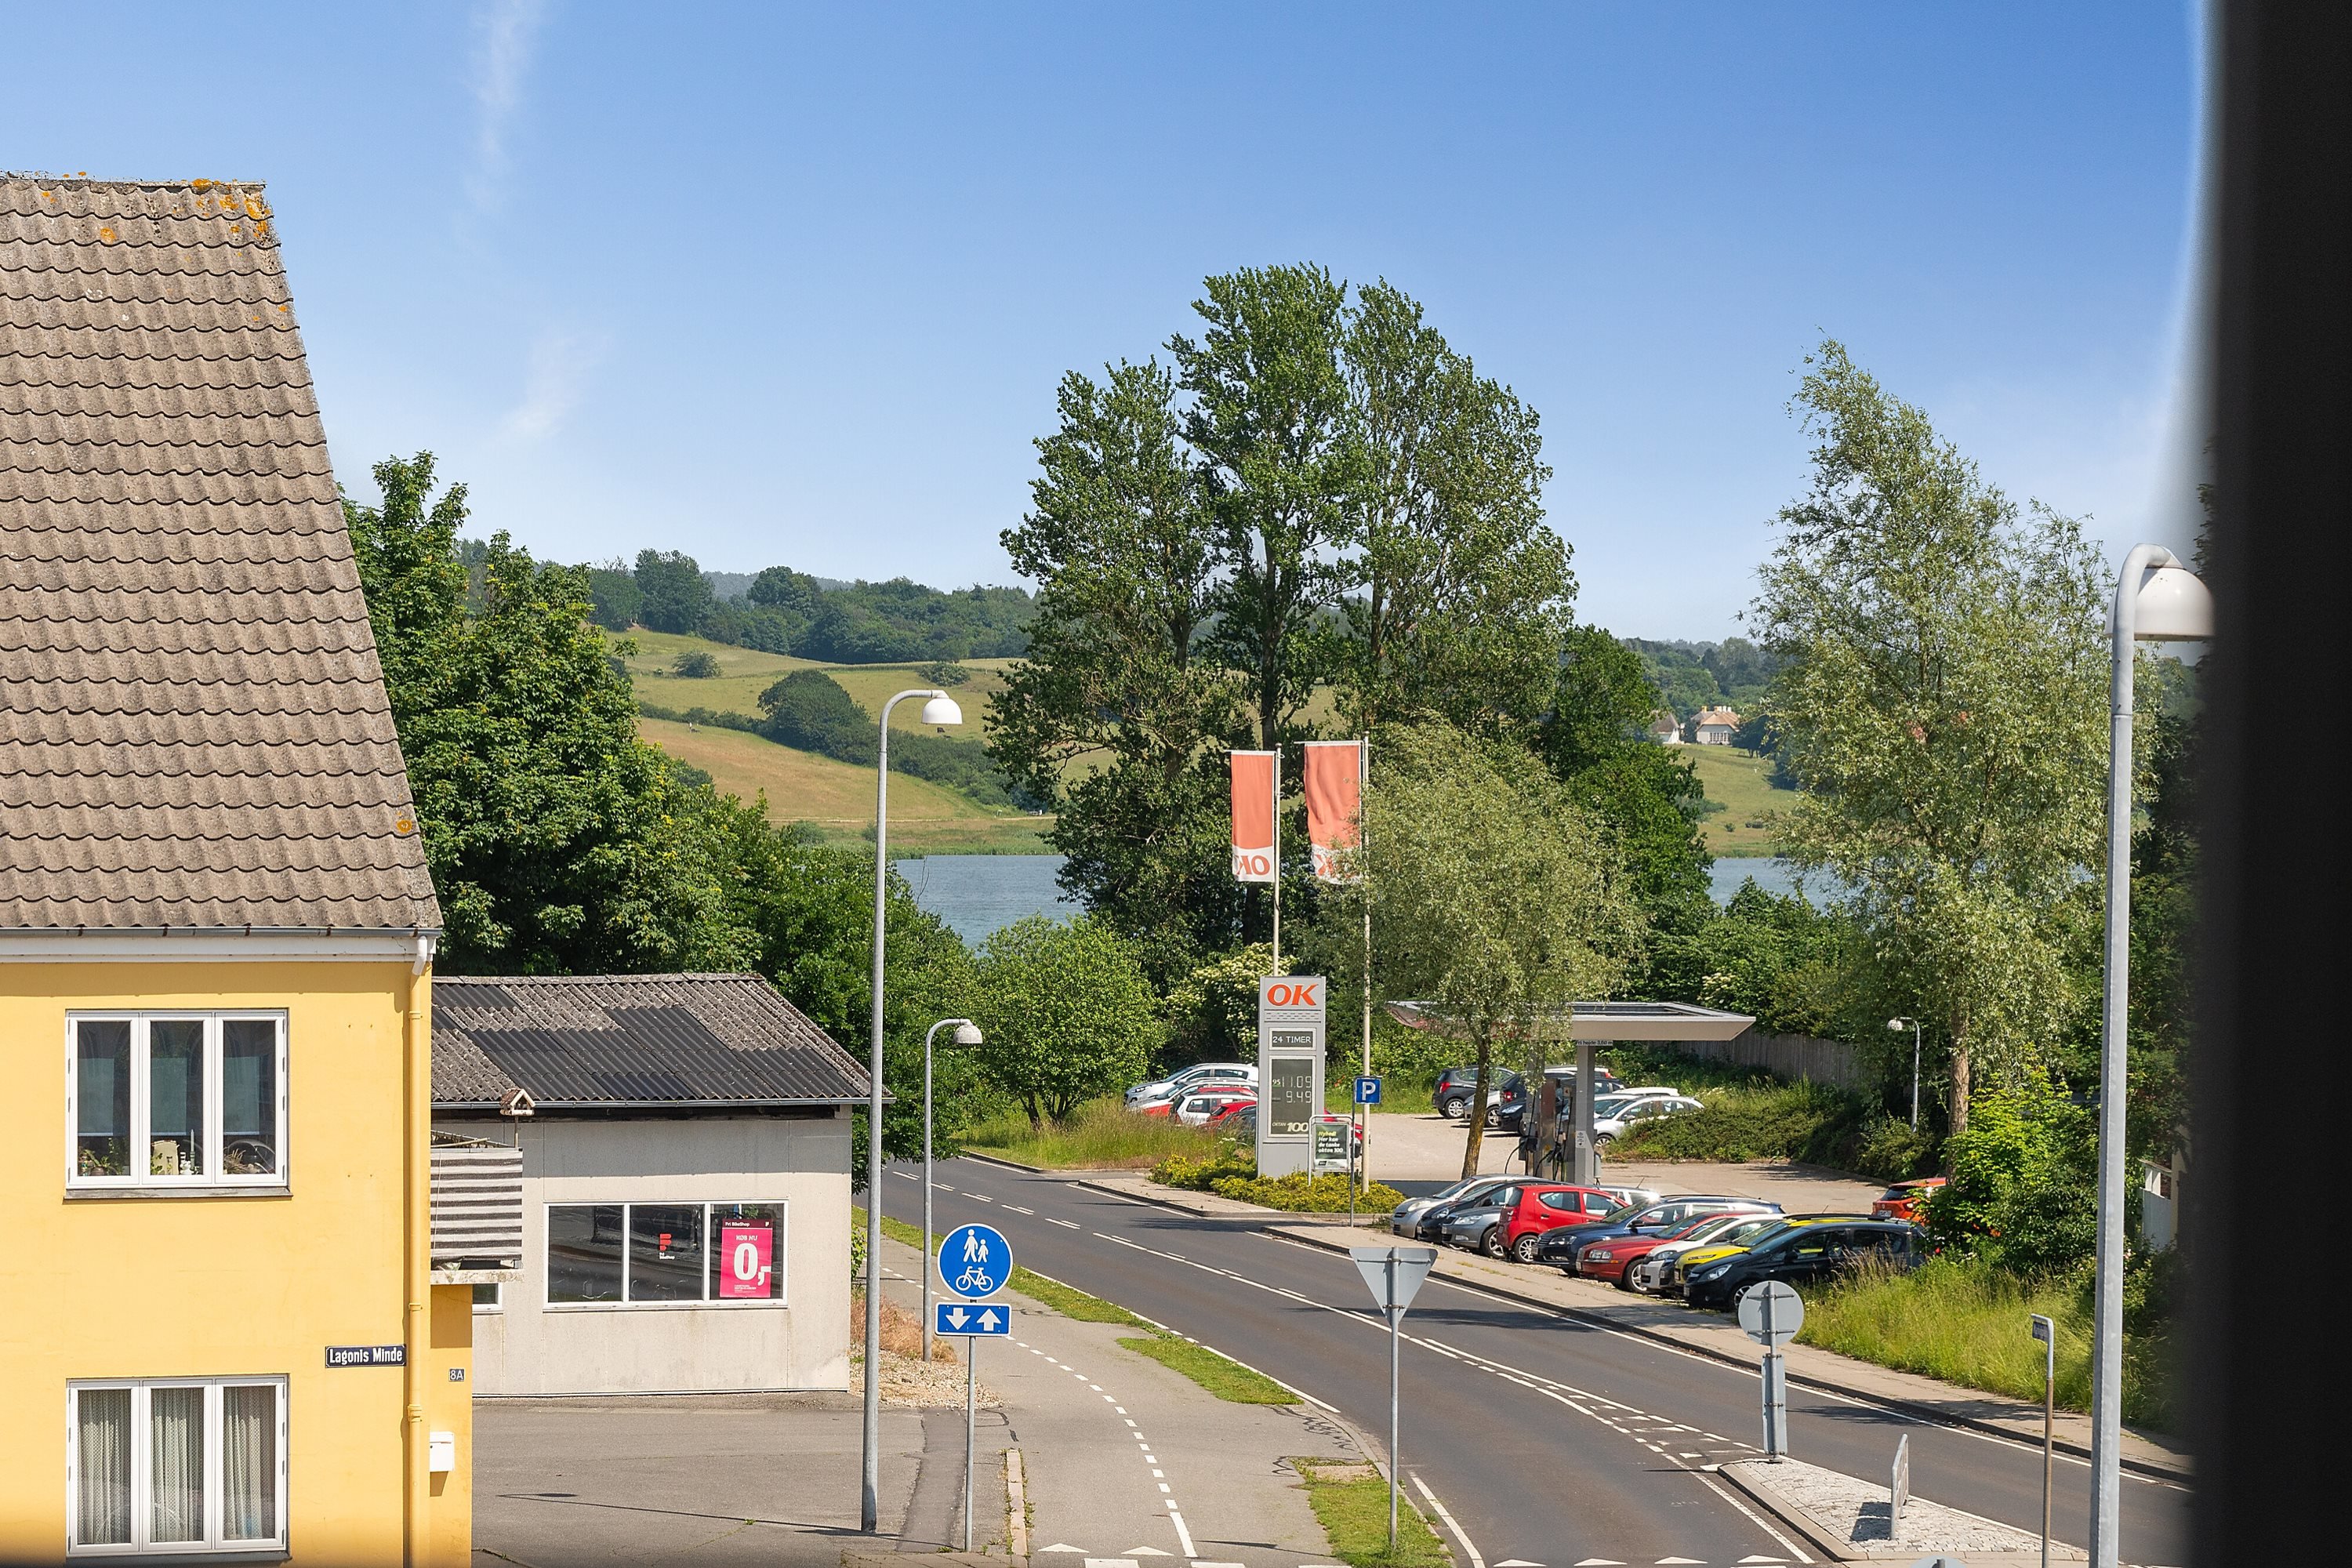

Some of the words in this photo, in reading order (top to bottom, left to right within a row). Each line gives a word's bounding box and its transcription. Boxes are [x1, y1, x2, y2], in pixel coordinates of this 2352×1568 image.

[1267, 983, 1319, 1007] OK
[1362, 1081, 1376, 1101] P
[1287, 1122, 1309, 1132] 100
[329, 1348, 369, 1365] Lagonis
[372, 1347, 403, 1363] Minde
[449, 1370, 464, 1381] 8A
